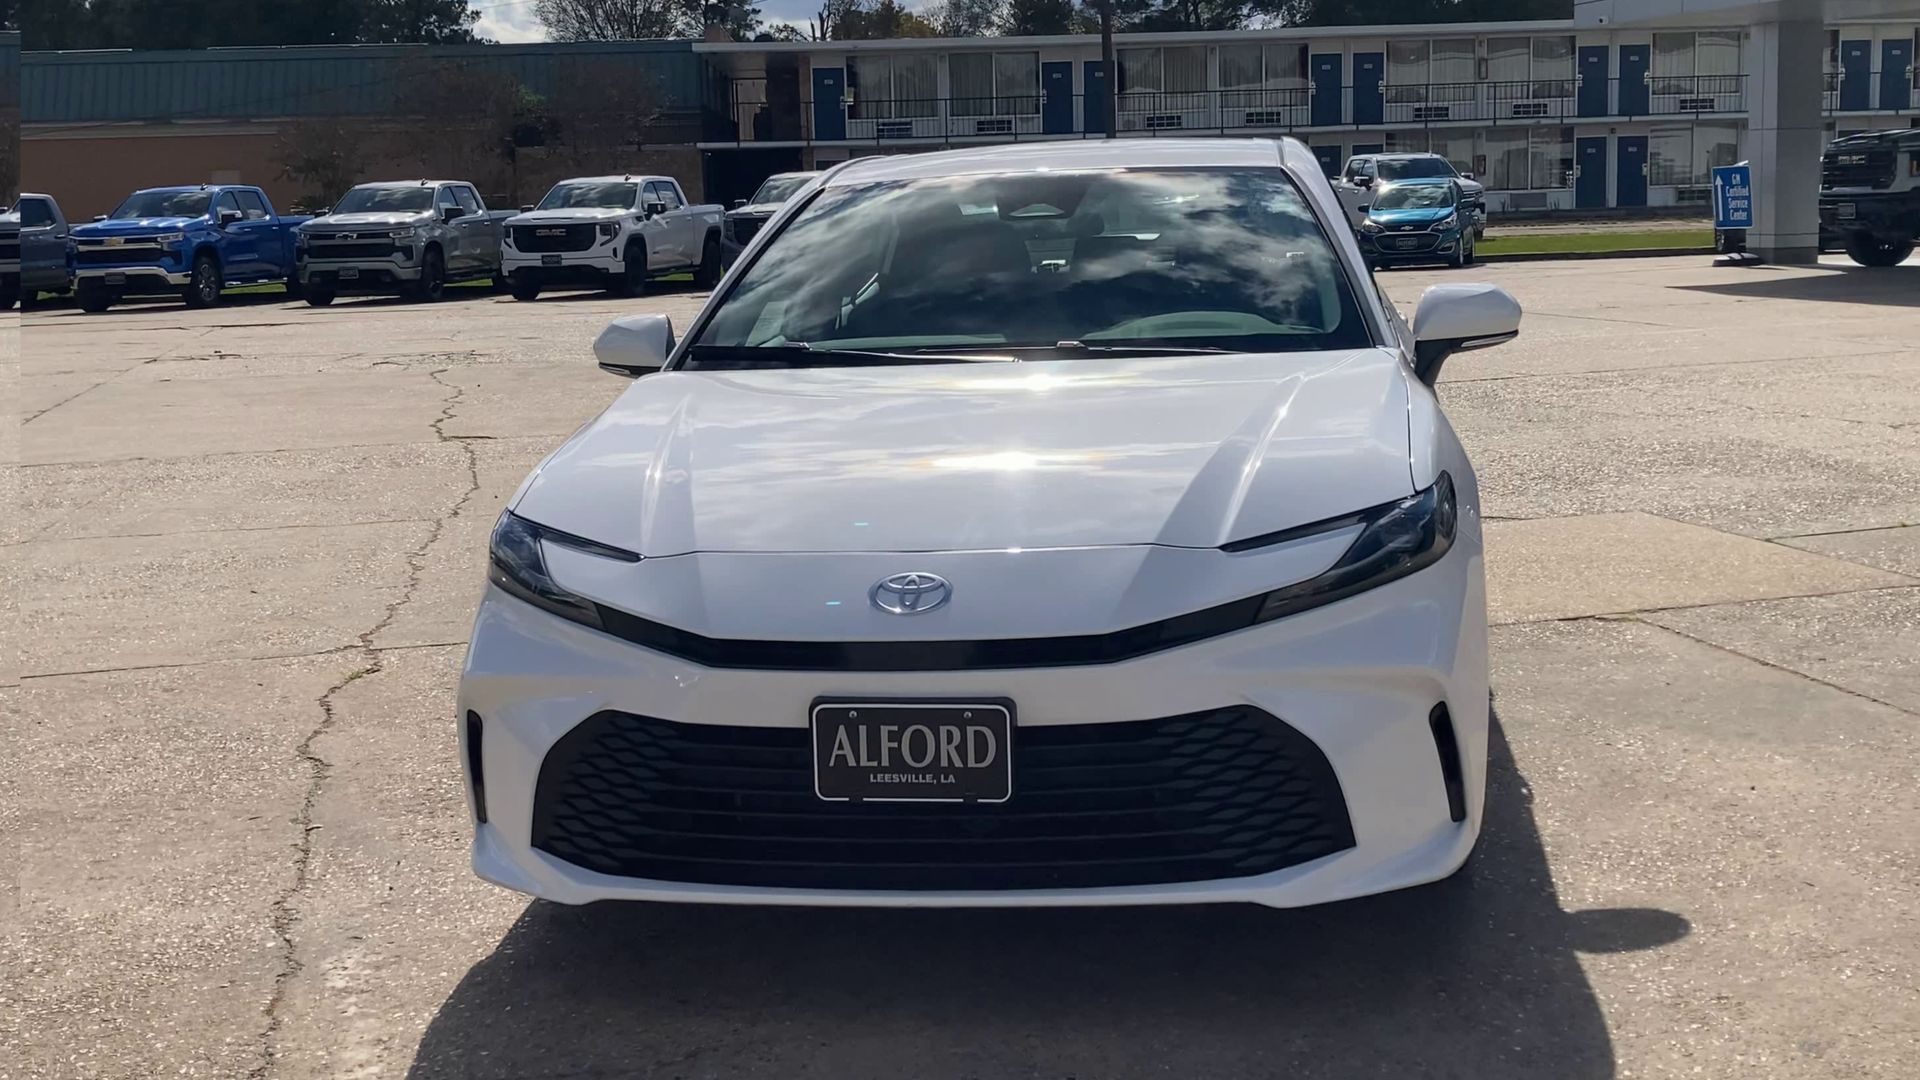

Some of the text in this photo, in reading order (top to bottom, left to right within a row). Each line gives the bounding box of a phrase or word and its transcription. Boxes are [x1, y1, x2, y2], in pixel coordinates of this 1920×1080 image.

[1725, 185, 1749, 197] Certified
[1728, 198, 1748, 209] Service
[1729, 209, 1747, 220] Center
[829, 724, 996, 768] ALFORD
[870, 773, 955, 784] LEESVILLE, LA
